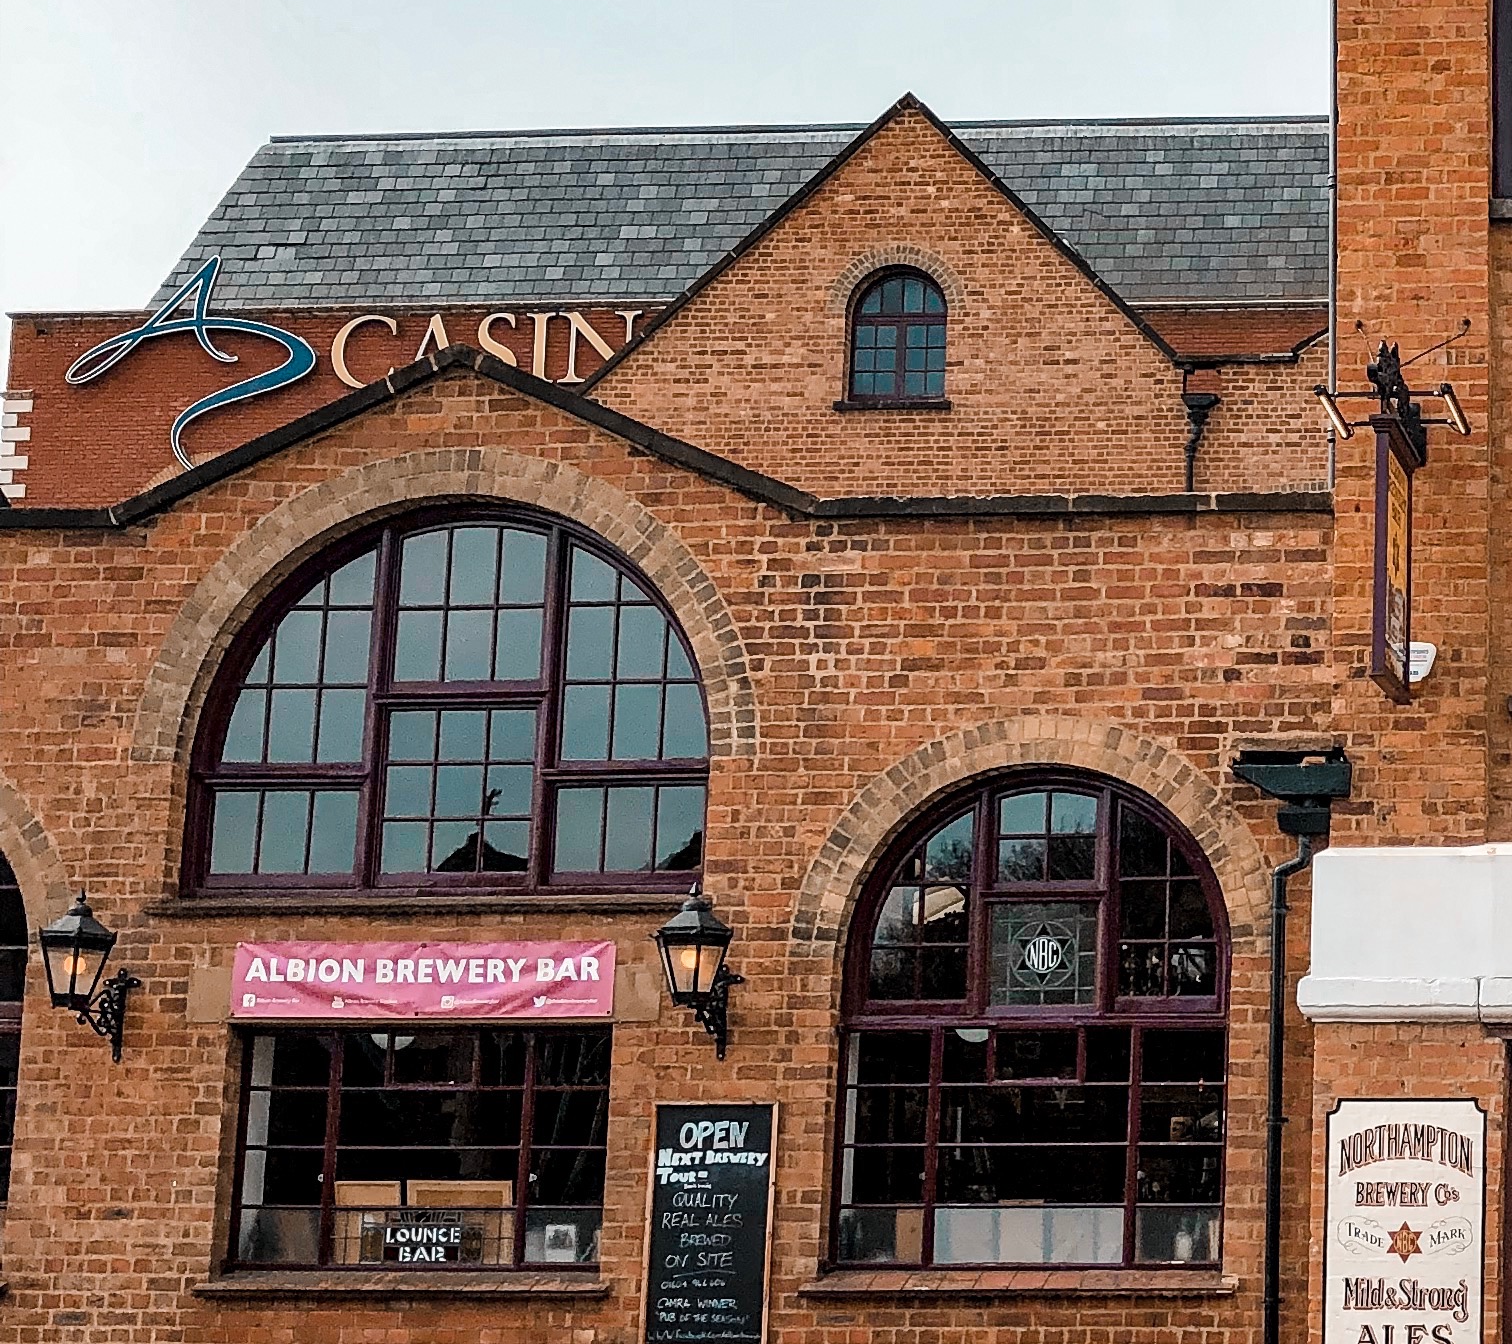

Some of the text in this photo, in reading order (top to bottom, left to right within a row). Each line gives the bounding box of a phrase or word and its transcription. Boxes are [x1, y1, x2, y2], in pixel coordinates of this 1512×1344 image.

[1029, 939, 1058, 971] NBC
[245, 956, 600, 984] ALBION BREWERY BAR
[679, 1120, 750, 1149] OPEN
[1338, 1123, 1474, 1178] NORTHAMPTON
[672, 1191, 739, 1211] QUALITY
[1354, 1181, 1432, 1207] BREWERY
[661, 1212, 744, 1230] REAL ALES
[679, 1232, 732, 1249] BREWED
[1345, 1221, 1467, 1249] TRADE MARK
[398, 1246, 447, 1262] BAR
[664, 1252, 734, 1269] ON SITE
[697, 1298, 738, 1310] WINNER
